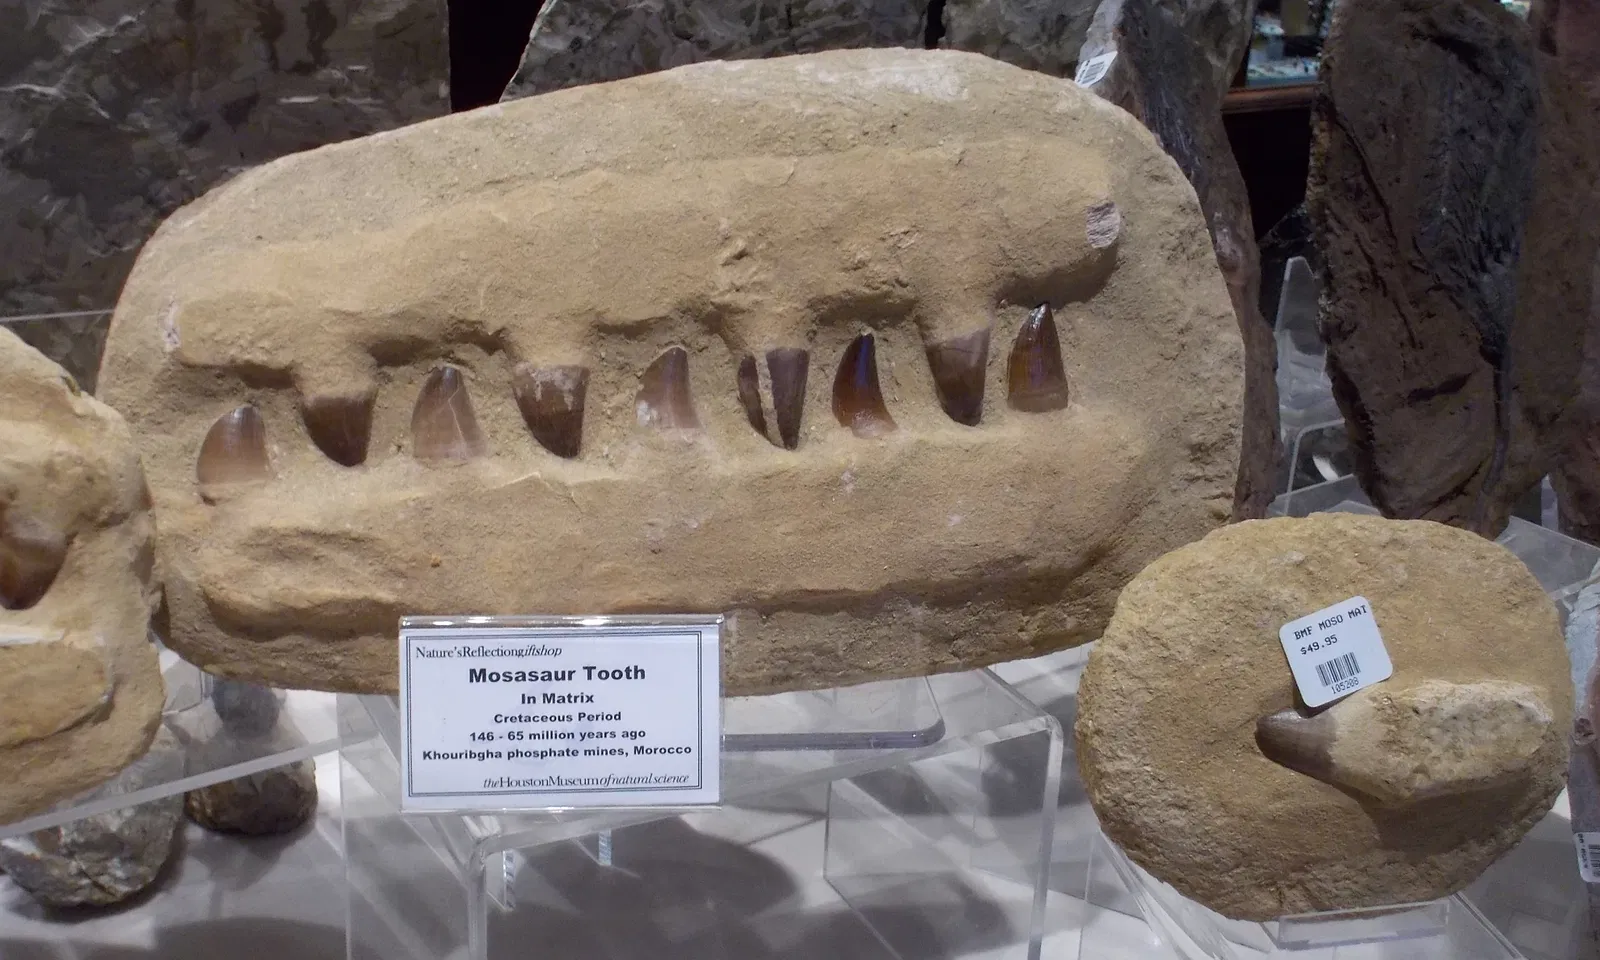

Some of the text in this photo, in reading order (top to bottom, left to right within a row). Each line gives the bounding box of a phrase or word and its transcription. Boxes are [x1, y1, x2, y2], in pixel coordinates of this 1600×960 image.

[1294, 605, 1368, 640] BMF MOSO MAT
[1300, 634, 1338, 655] $49.95
[469, 665, 646, 683] Mosasaur Tooth
[521, 692, 595, 704] In Matrix
[494, 711, 622, 723] Cretaceous Period
[469, 731, 495, 741] 146
[507, 731, 524, 741] 65
[529, 730, 575, 740] million
[579, 730, 617, 742] years
[621, 730, 646, 741] ago
[422, 745, 692, 761] Khouribgha phosphate mines, Morocco
